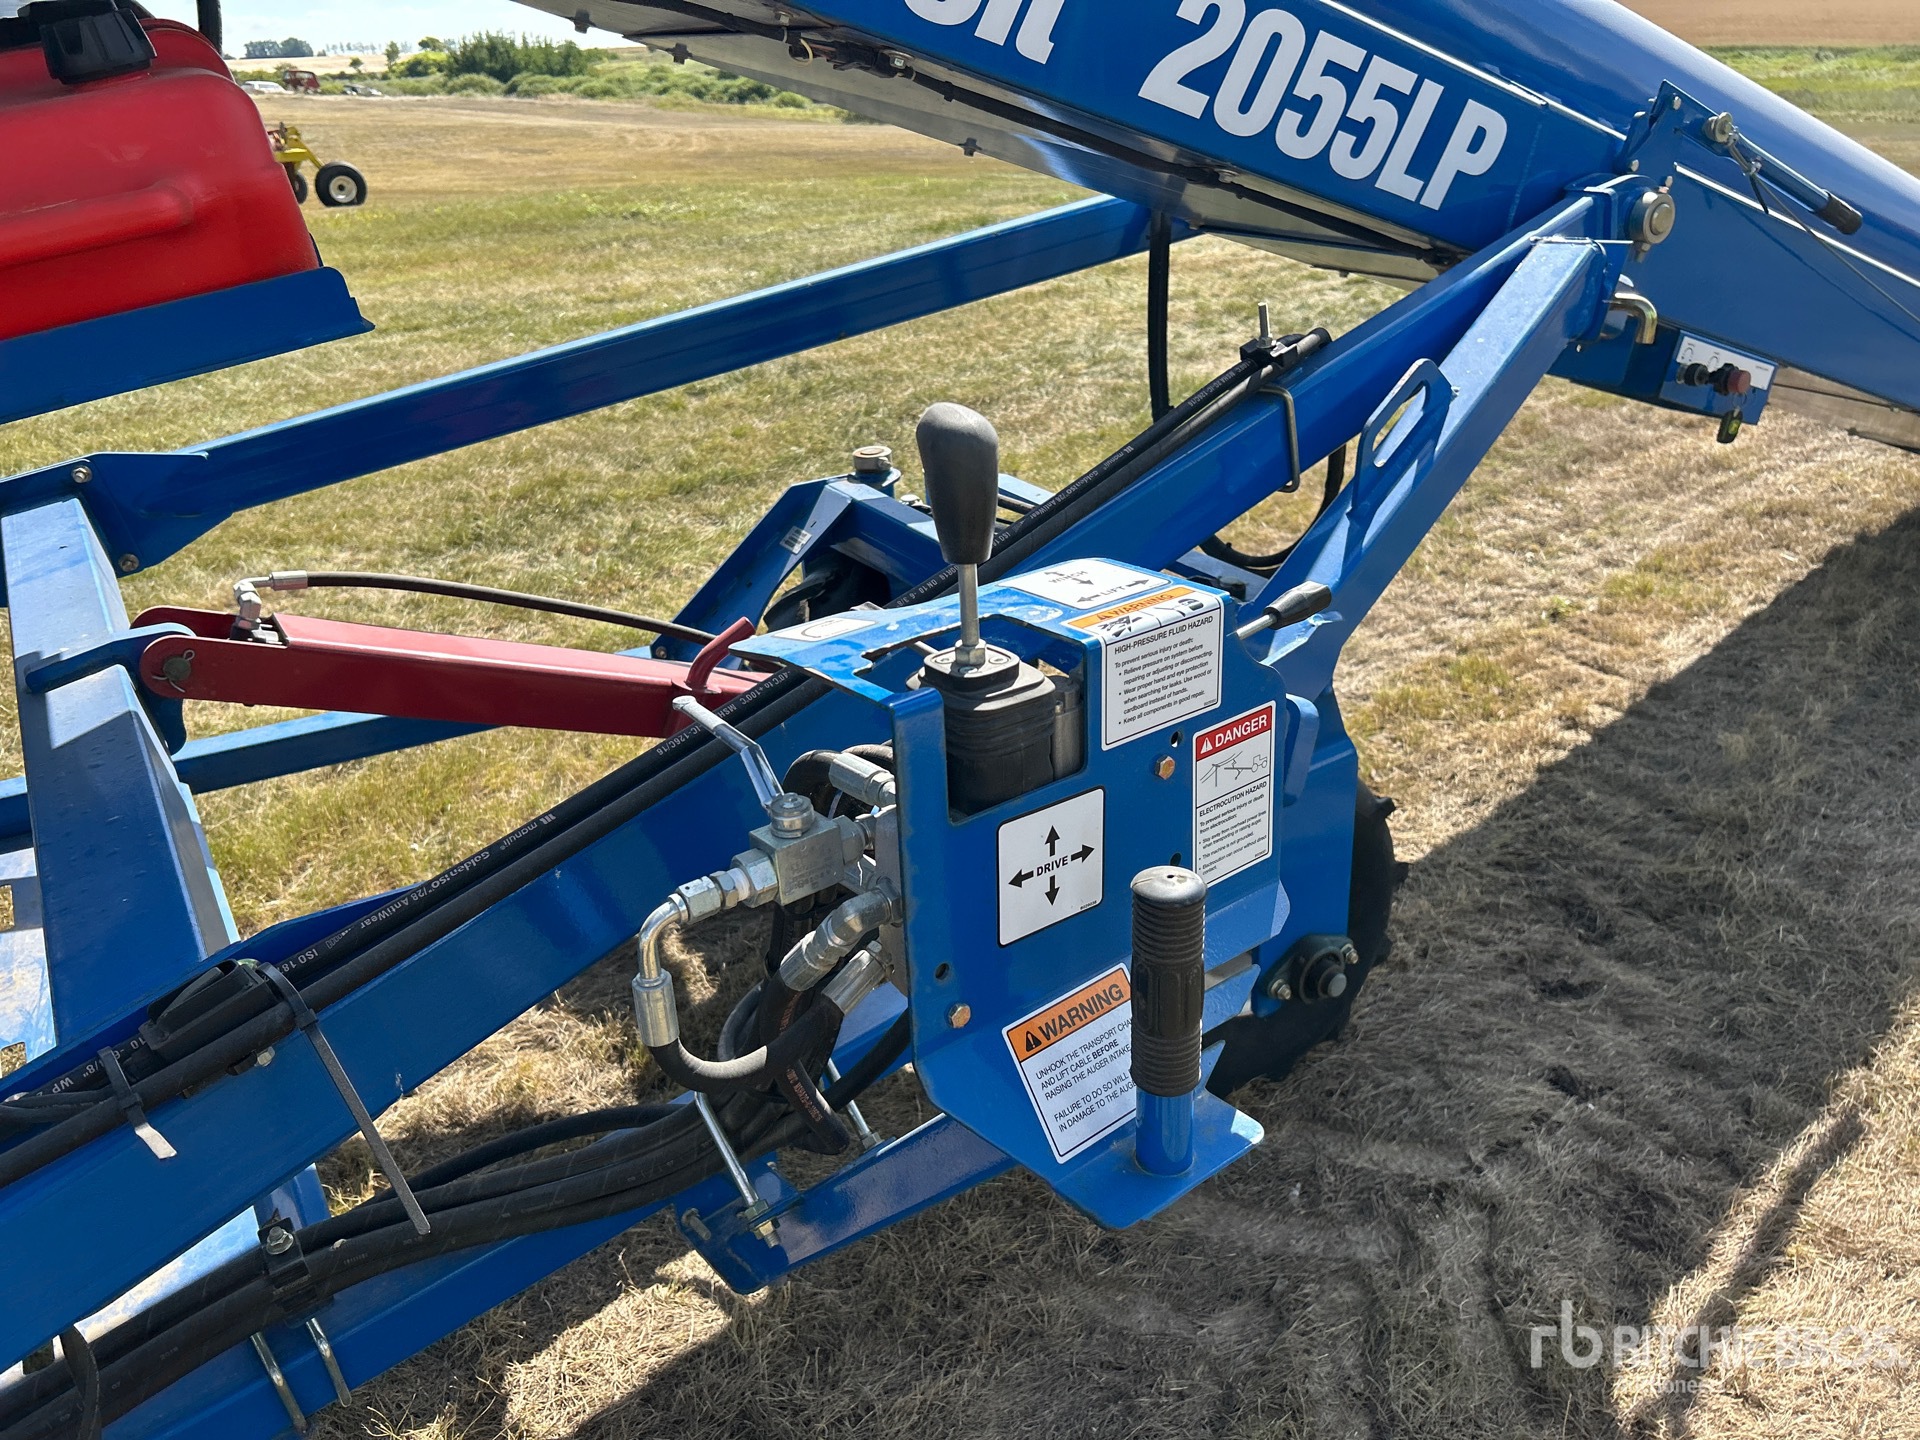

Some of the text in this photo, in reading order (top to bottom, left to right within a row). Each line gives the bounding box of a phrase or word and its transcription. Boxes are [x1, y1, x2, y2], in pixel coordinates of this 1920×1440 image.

[1137, 0, 1508, 210] 2055LP
[1101, 586, 1125, 596] LIFT
[1111, 594, 1175, 618] WARNING
[1114, 615, 1213, 654] HIGH-PRESSURE FLUID HAZARD
[1121, 654, 1140, 667] prevent
[1141, 649, 1157, 659] serious
[1159, 644, 1171, 654] injury
[1123, 664, 1141, 675] Relieve
[1142, 657, 1162, 669] pressure
[1170, 648, 1187, 660] system
[1188, 642, 1202, 652] before
[1123, 672, 1144, 686] repairing
[1152, 663, 1173, 676] adjusting
[1123, 660, 1208, 695] Wear proper hand and eye protection
[1124, 695, 1136, 704] when
[1138, 686, 1160, 700] searching
[1193, 670, 1205, 679] wood
[715, 702, 737, 719] MSH
[1123, 700, 1147, 714] cardboard
[1149, 694, 1165, 705] instead
[1123, 715, 1135, 724] Keep
[1143, 701, 1172, 717] components
[1178, 694, 1190, 704] good
[1215, 713, 1267, 748] DANGER
[1199, 780, 1266, 817] ELECTROCUTION HAZARD
[1036, 854, 1068, 877] DRIVE
[358, 896, 411, 931] AntiWear
[296, 947, 318, 964] ISO
[1037, 980, 1124, 1043] WARNING
[1035, 1015, 1134, 1080] UNHOOK THE TRANSPORT CHA
[1039, 1037, 1119, 1090] AND LIFT CABLE BEFORE
[49, 1075, 74, 1094] WP
[1044, 1078, 1073, 1101] RAISING
[1071, 1070, 1086, 1084] THE
[1085, 1056, 1109, 1076] AUGER
[1053, 1099, 1082, 1122] FAILURE
[1081, 1093, 1092, 1105] TO
[1091, 1086, 1103, 1099] DO
[1101, 1080, 1113, 1092] SO
[1112, 1070, 1128, 1086] WILL
[1058, 1122, 1067, 1132] IN
[1066, 1104, 1096, 1127] DAMAGE
[1094, 1097, 1105, 1109] TO
[1104, 1089, 1119, 1103] THE
